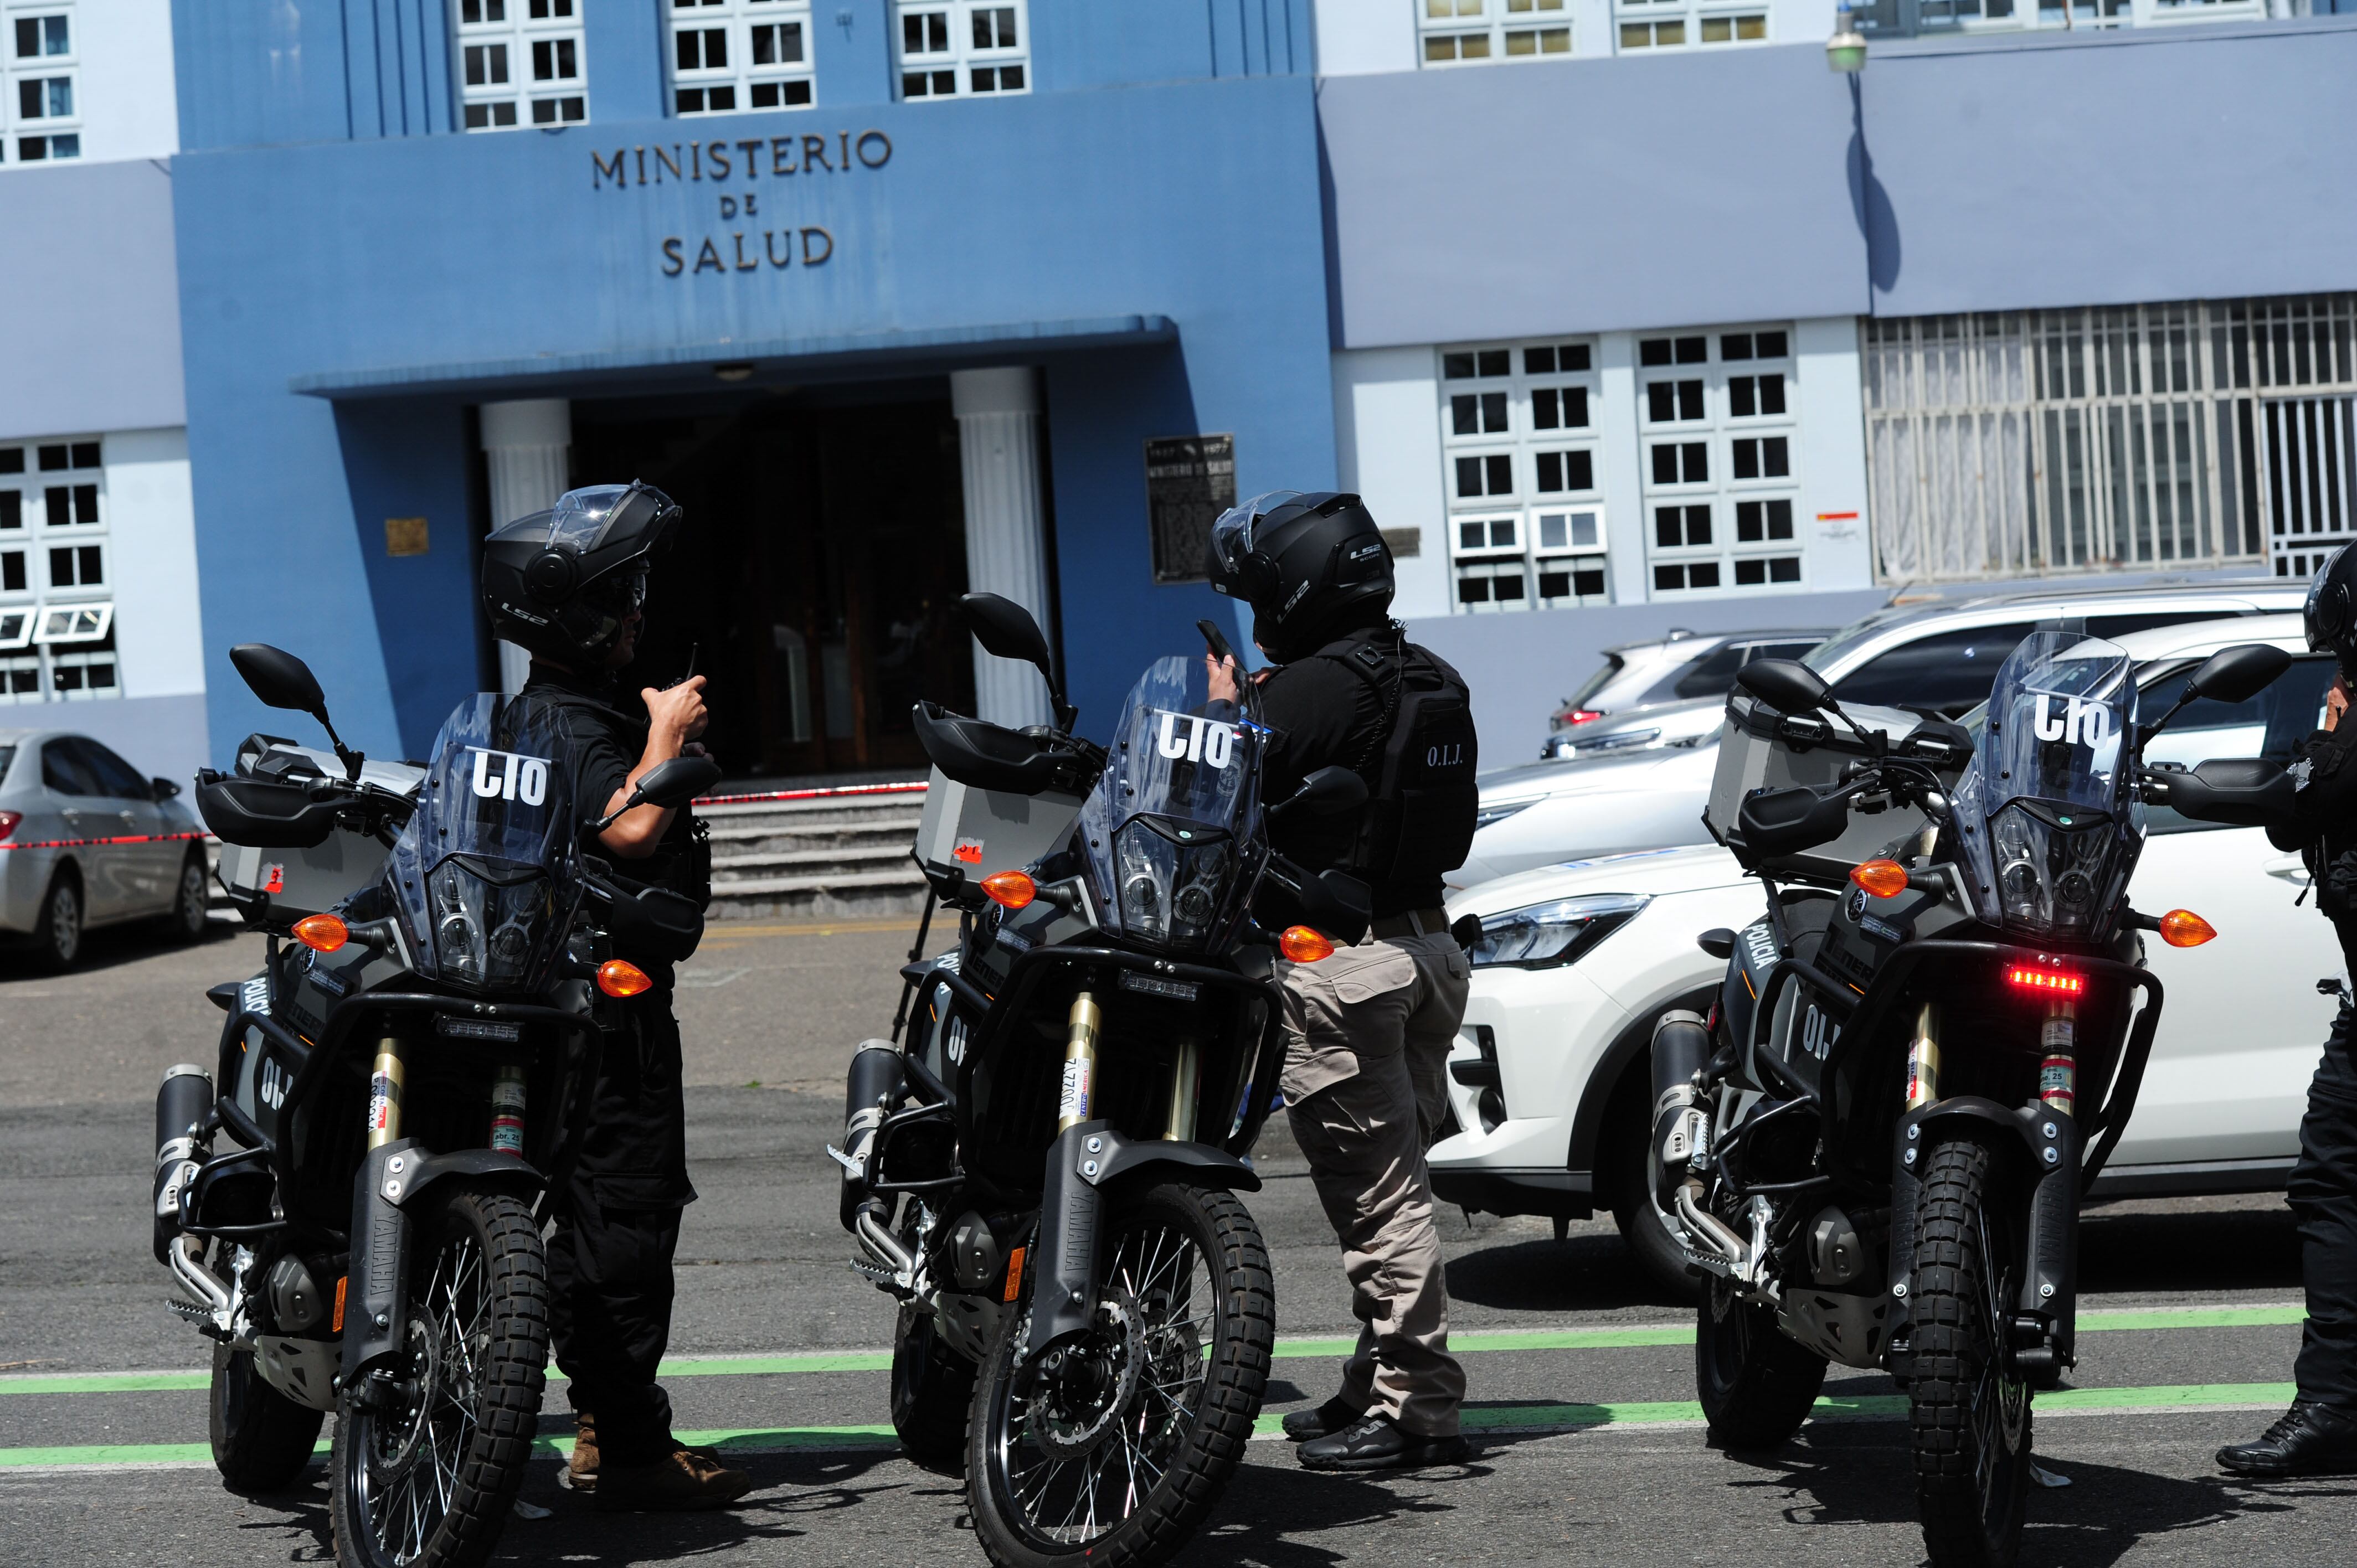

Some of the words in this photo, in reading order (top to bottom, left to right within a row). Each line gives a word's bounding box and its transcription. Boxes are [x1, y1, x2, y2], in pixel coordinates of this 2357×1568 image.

[591, 129, 892, 190] MINISTERIO
[720, 193, 757, 219] DE
[662, 226, 834, 277] SALUD
[1350, 543, 1381, 560] LS2
[501, 602, 549, 627] LS2
[1277, 579, 1310, 625] LS2
[1427, 744, 1463, 766] O.I.J.
[1745, 923, 1782, 970] POLICIA
[495, 1132, 510, 1140] abr.
[511, 1133, 520, 1142] 25
[370, 1210, 399, 1296] YAMAHA
[1064, 1190, 1095, 1271] YAMAHA
